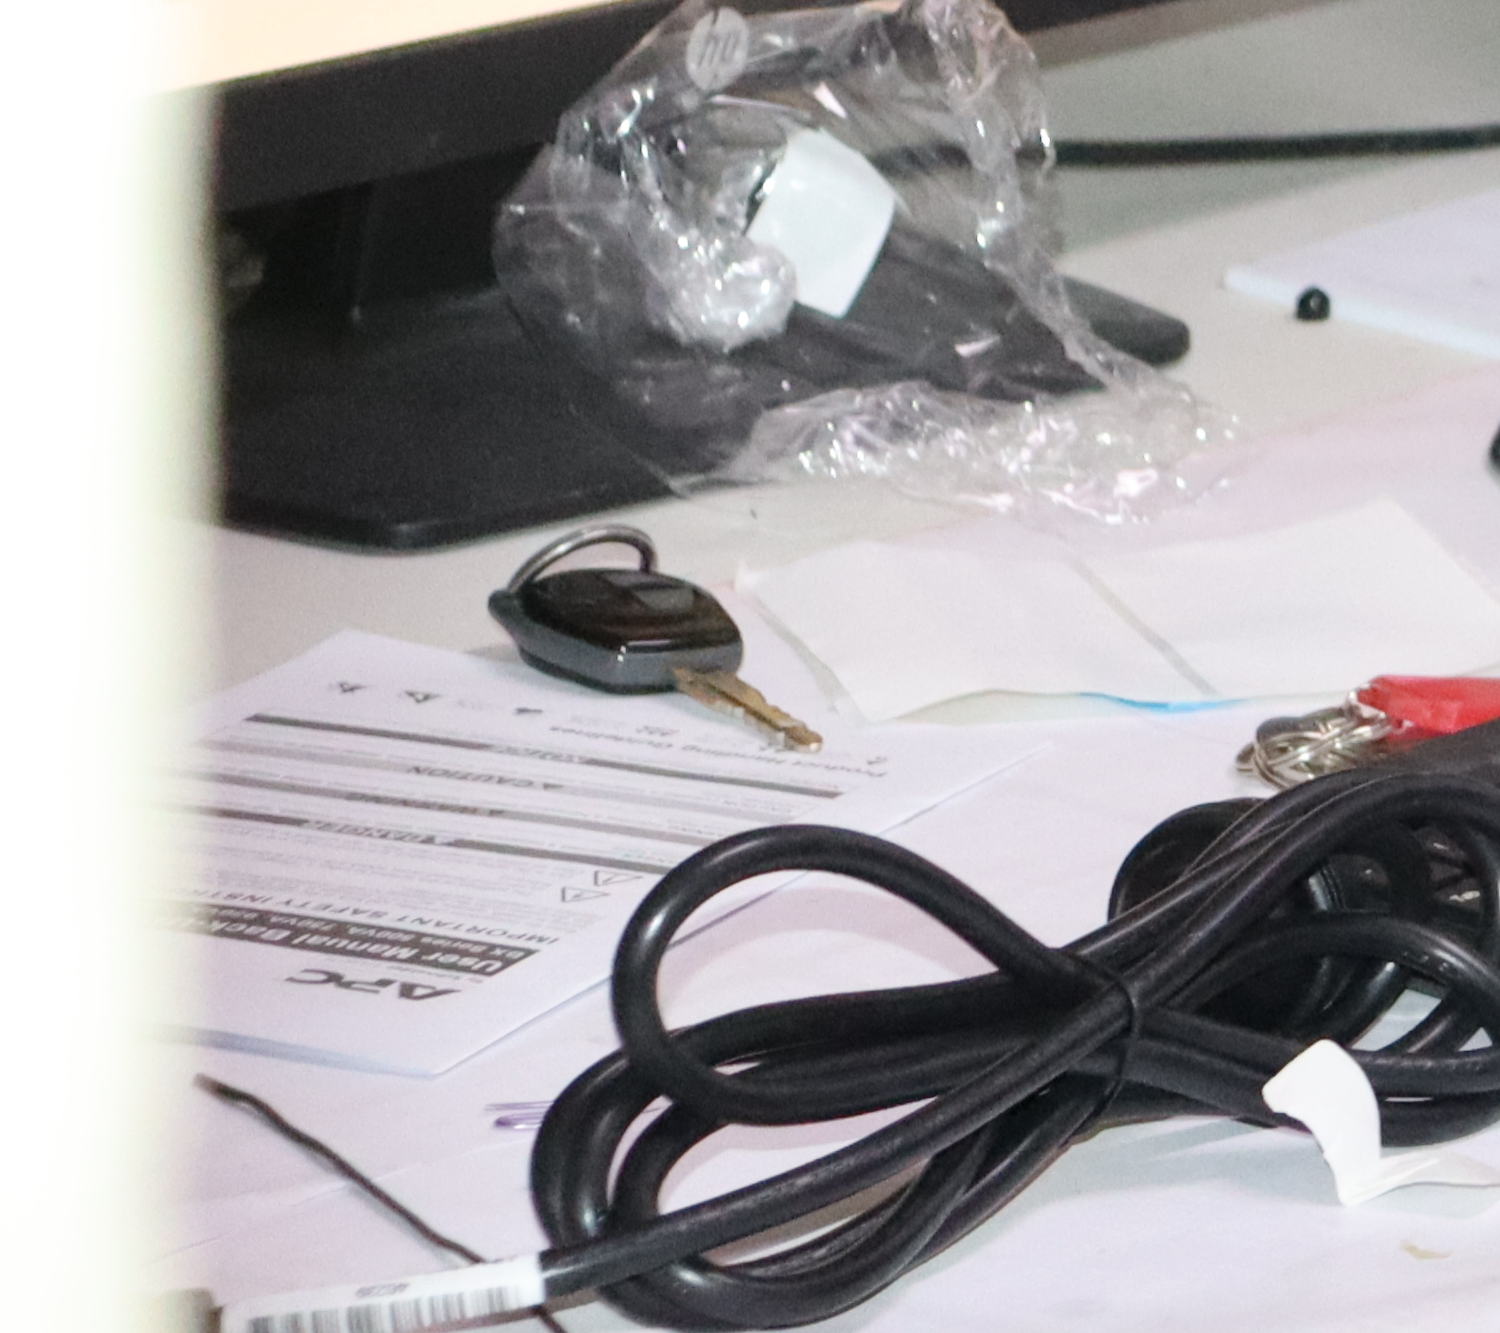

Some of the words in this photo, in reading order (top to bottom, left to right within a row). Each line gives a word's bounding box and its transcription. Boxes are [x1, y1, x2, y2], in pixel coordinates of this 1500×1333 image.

[546, 724, 674, 749] Guidelines
[681, 743, 788, 765] Handling
[405, 763, 536, 788] CAUTION
[792, 758, 888, 778] Product
[271, 896, 387, 920] SAFETY
[398, 914, 560, 945] IMPORTANT
[291, 932, 418, 960] Manual
[419, 936, 488, 952] Series
[420, 951, 503, 973] User
[284, 968, 461, 1001] APC
